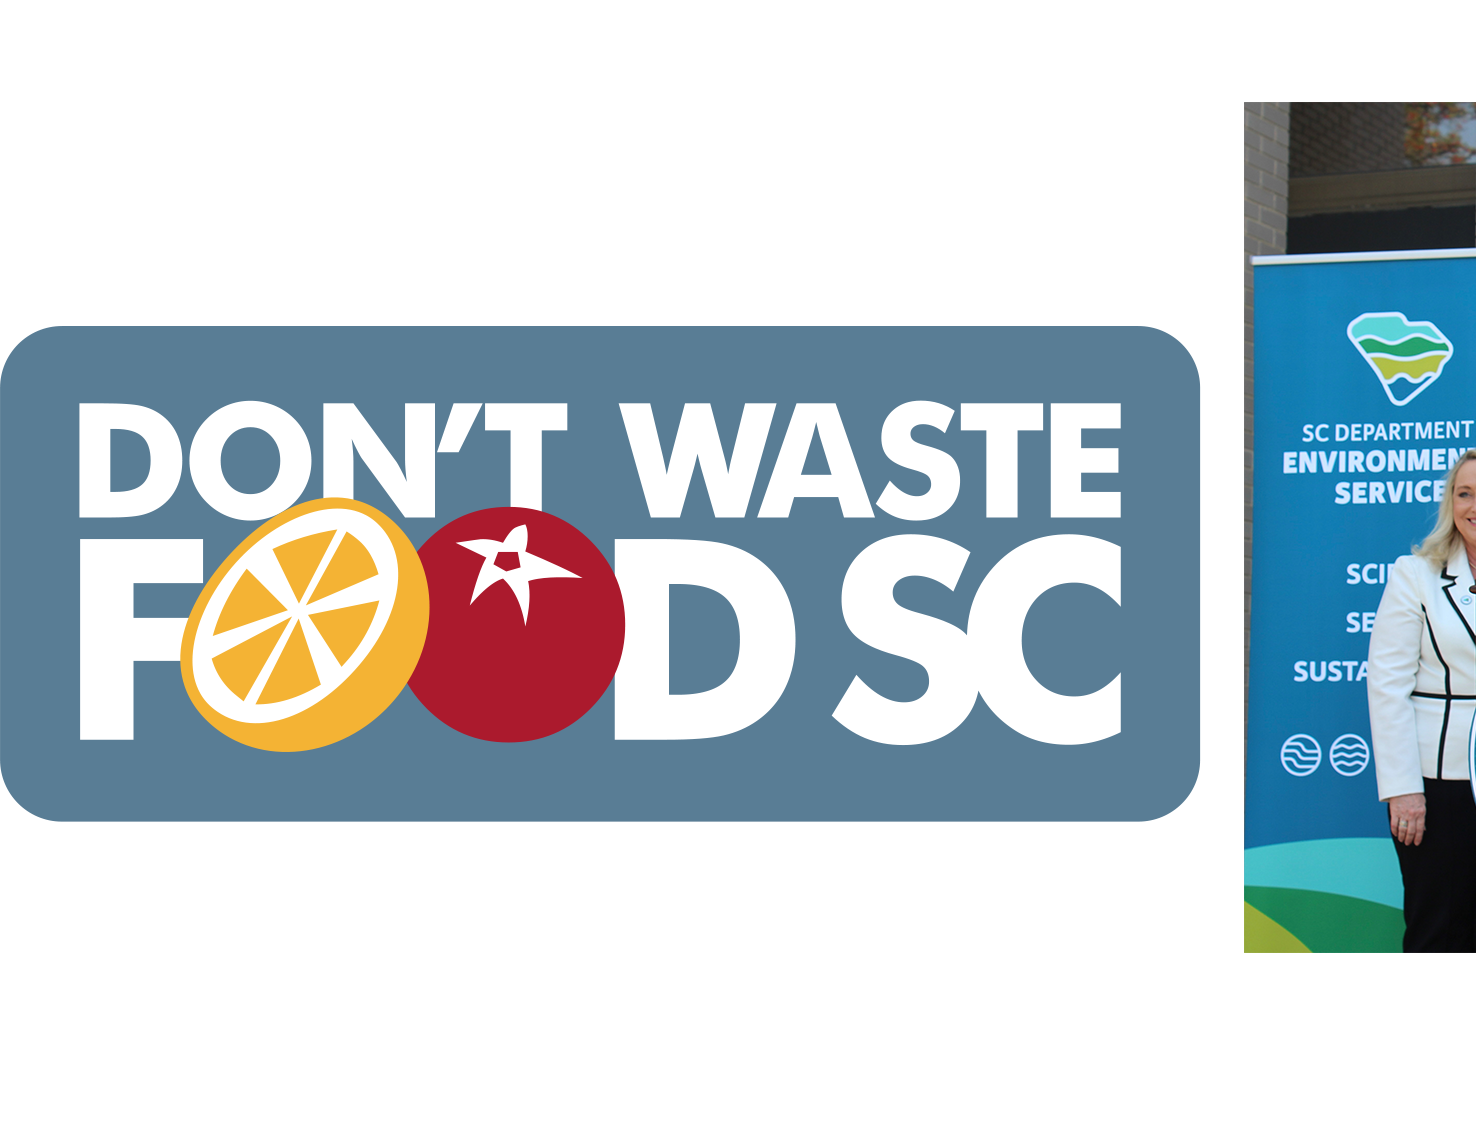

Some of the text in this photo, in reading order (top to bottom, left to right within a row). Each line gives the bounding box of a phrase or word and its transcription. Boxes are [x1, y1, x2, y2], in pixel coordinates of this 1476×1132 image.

[78, 400, 1121, 521] DON'T WASTE
[1302, 424, 1329, 442] SC
[1335, 420, 1474, 442] DEPARTMENT
[1335, 480, 1446, 505] SERVICE
[831, 533, 1121, 745] SC
